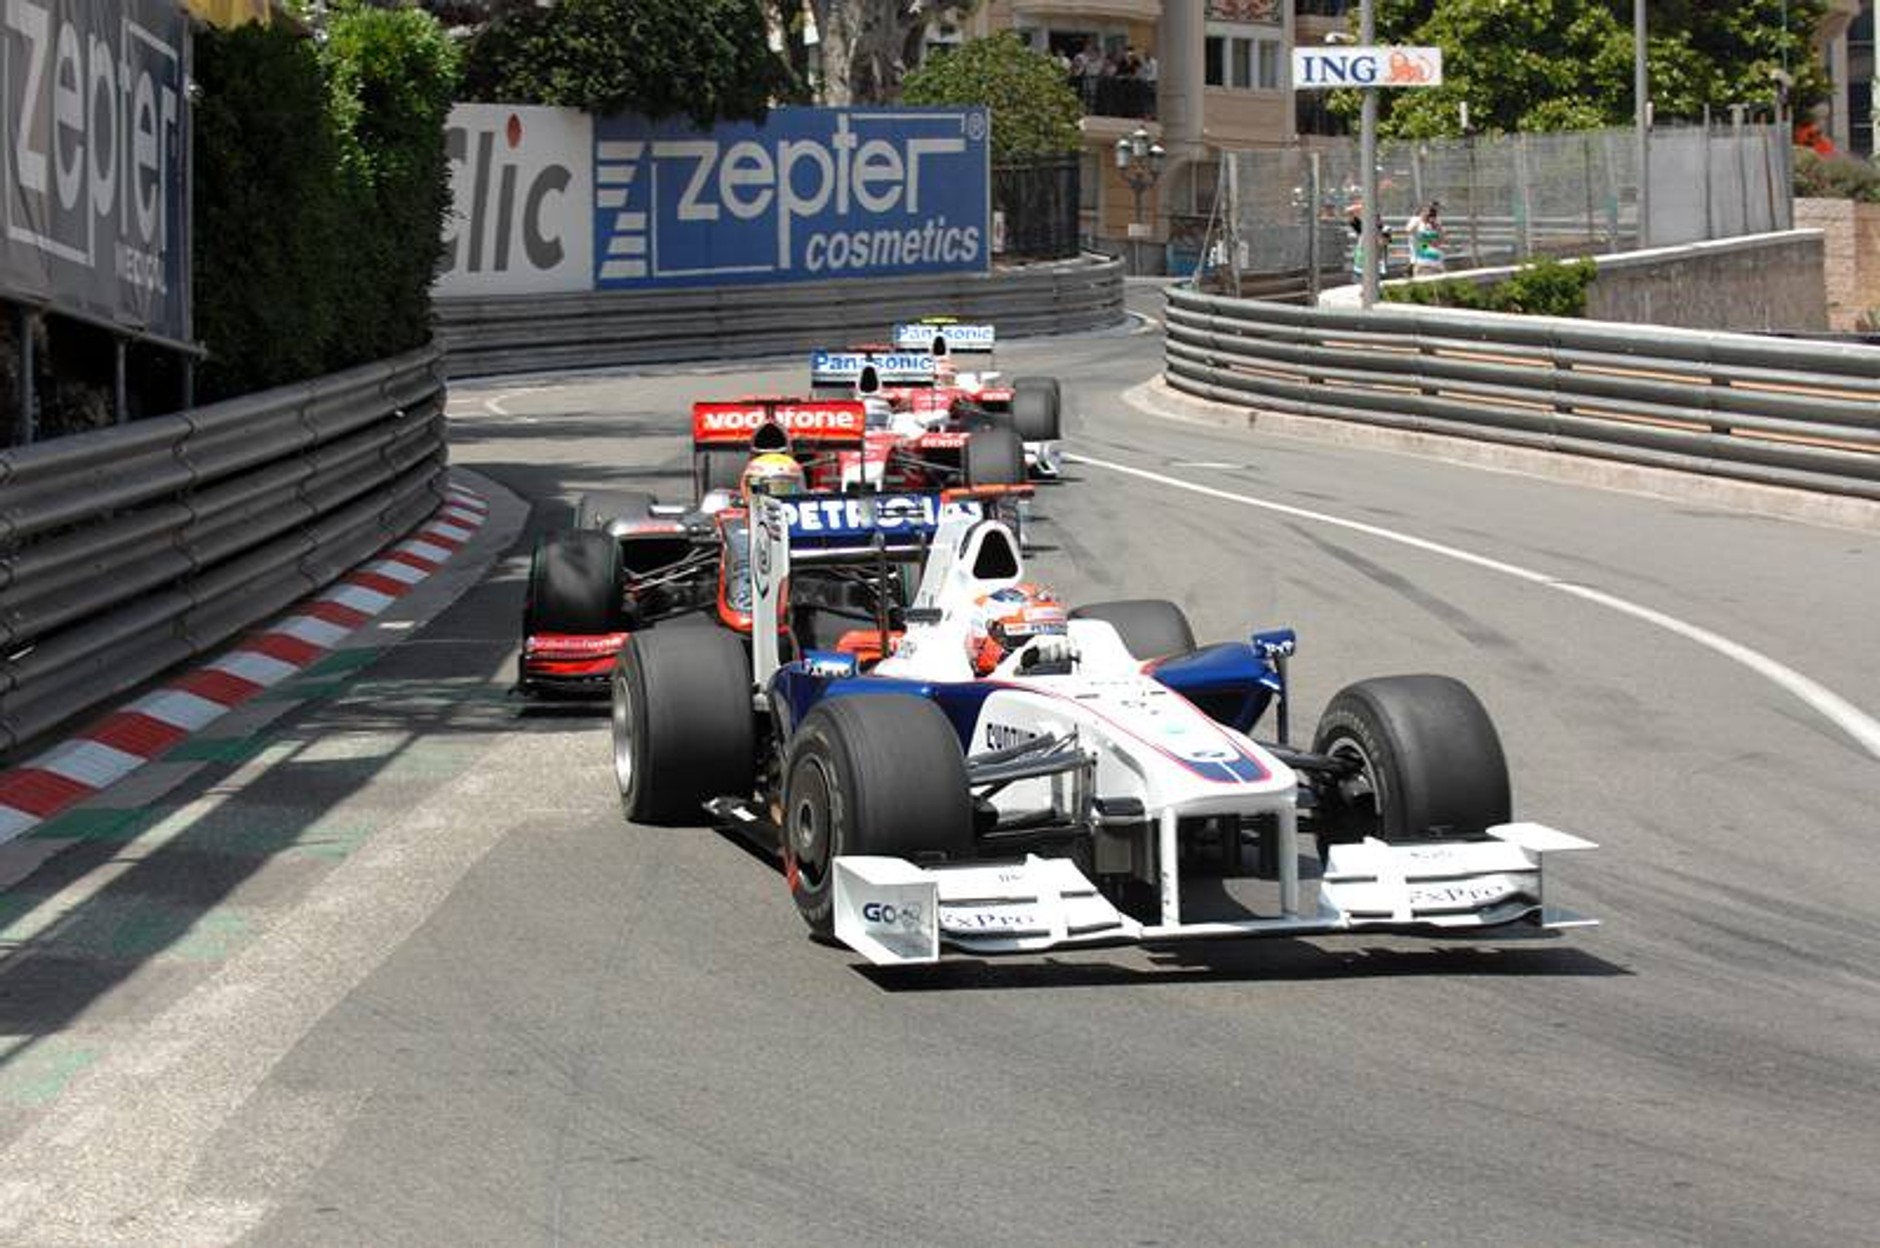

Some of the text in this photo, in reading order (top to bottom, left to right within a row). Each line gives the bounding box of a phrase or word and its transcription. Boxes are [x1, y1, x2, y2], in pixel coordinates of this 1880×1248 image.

[1302, 56, 1377, 83] ING
[651, 113, 966, 270] zepter
[805, 216, 980, 272] cosmetics
[894, 322, 993, 341] Pansonic
[813, 350, 933, 371] Pansonic
[704, 409, 855, 429] vodfone
